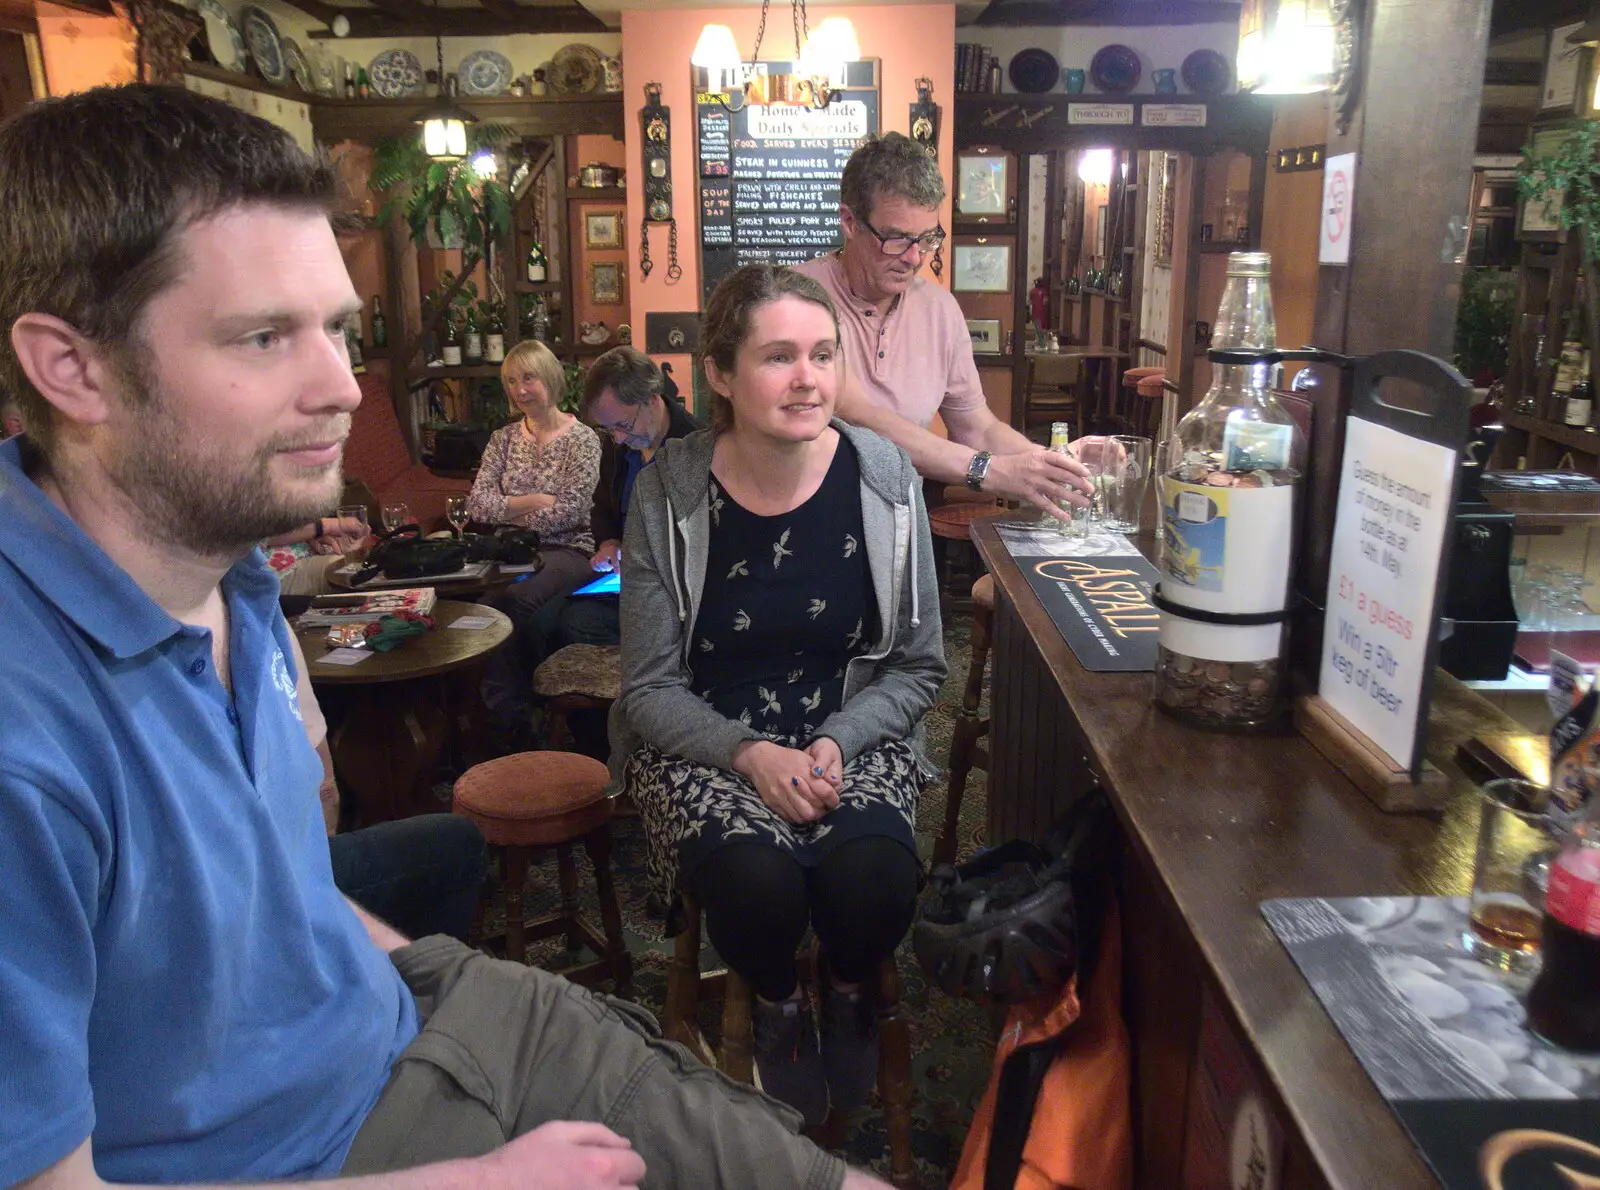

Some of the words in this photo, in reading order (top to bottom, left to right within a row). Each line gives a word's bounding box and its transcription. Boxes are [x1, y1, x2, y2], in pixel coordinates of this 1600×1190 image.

[761, 104, 800, 116] Home
[818, 104, 856, 116] Made
[1075, 110, 1114, 118] THROUGH
[1116, 110, 1128, 118] TO
[758, 121, 793, 137] Daily
[801, 121, 860, 137] Specials
[734, 139, 758, 149] FOOD
[763, 139, 796, 149] SERVED
[801, 139, 828, 149] EVERY
[735, 156, 764, 168] STEAK
[768, 158, 778, 167] IN
[781, 158, 829, 168] GUINNESS
[702, 188, 729, 197] SOUP
[737, 183, 762, 192] PRAWN
[764, 183, 782, 192] WITH
[784, 183, 807, 191] CHILLI
[736, 192, 762, 200] FILLING
[769, 192, 823, 201] FISHCAKES
[704, 199, 715, 208] OF
[717, 200, 730, 208] THE
[735, 200, 760, 209] SERVED
[762, 201, 778, 209] WITH
[780, 201, 801, 210] CHIPS
[803, 202, 817, 210] AND
[820, 201, 840, 211] SALAD
[705, 208, 725, 217] DAY
[736, 216, 764, 226] SMOKY
[768, 216, 797, 226] PULLED
[800, 216, 820, 226] PORK
[737, 229, 763, 237] SERVED
[784, 229, 808, 237] MASHED
[809, 229, 838, 237] POTATOES
[737, 236, 749, 244] AND
[788, 236, 832, 245] VEGETABLES
[775, 250, 807, 258] CHICKEN
[1353, 460, 1380, 487] Guess
[1381, 472, 1395, 493] the
[1396, 481, 1431, 510] amount
[1355, 487, 1367, 504] of
[1367, 493, 1393, 523] money
[1393, 505, 1404, 524] in
[1405, 507, 1421, 532] the
[1360, 513, 1385, 541] bottle
[1385, 528, 1398, 547] as
[1398, 535, 1410, 552] at
[1033, 560, 1160, 639] ASPALL
[1338, 573, 1355, 602] £1
[1358, 592, 1367, 611] a
[1369, 599, 1413, 640] guess
[1338, 616, 1361, 653] Win
[1364, 641, 1373, 661] a
[1376, 644, 1400, 679] 5ltr
[1332, 646, 1354, 685] keg
[1355, 668, 1371, 690] of
[1370, 674, 1403, 717] beer
